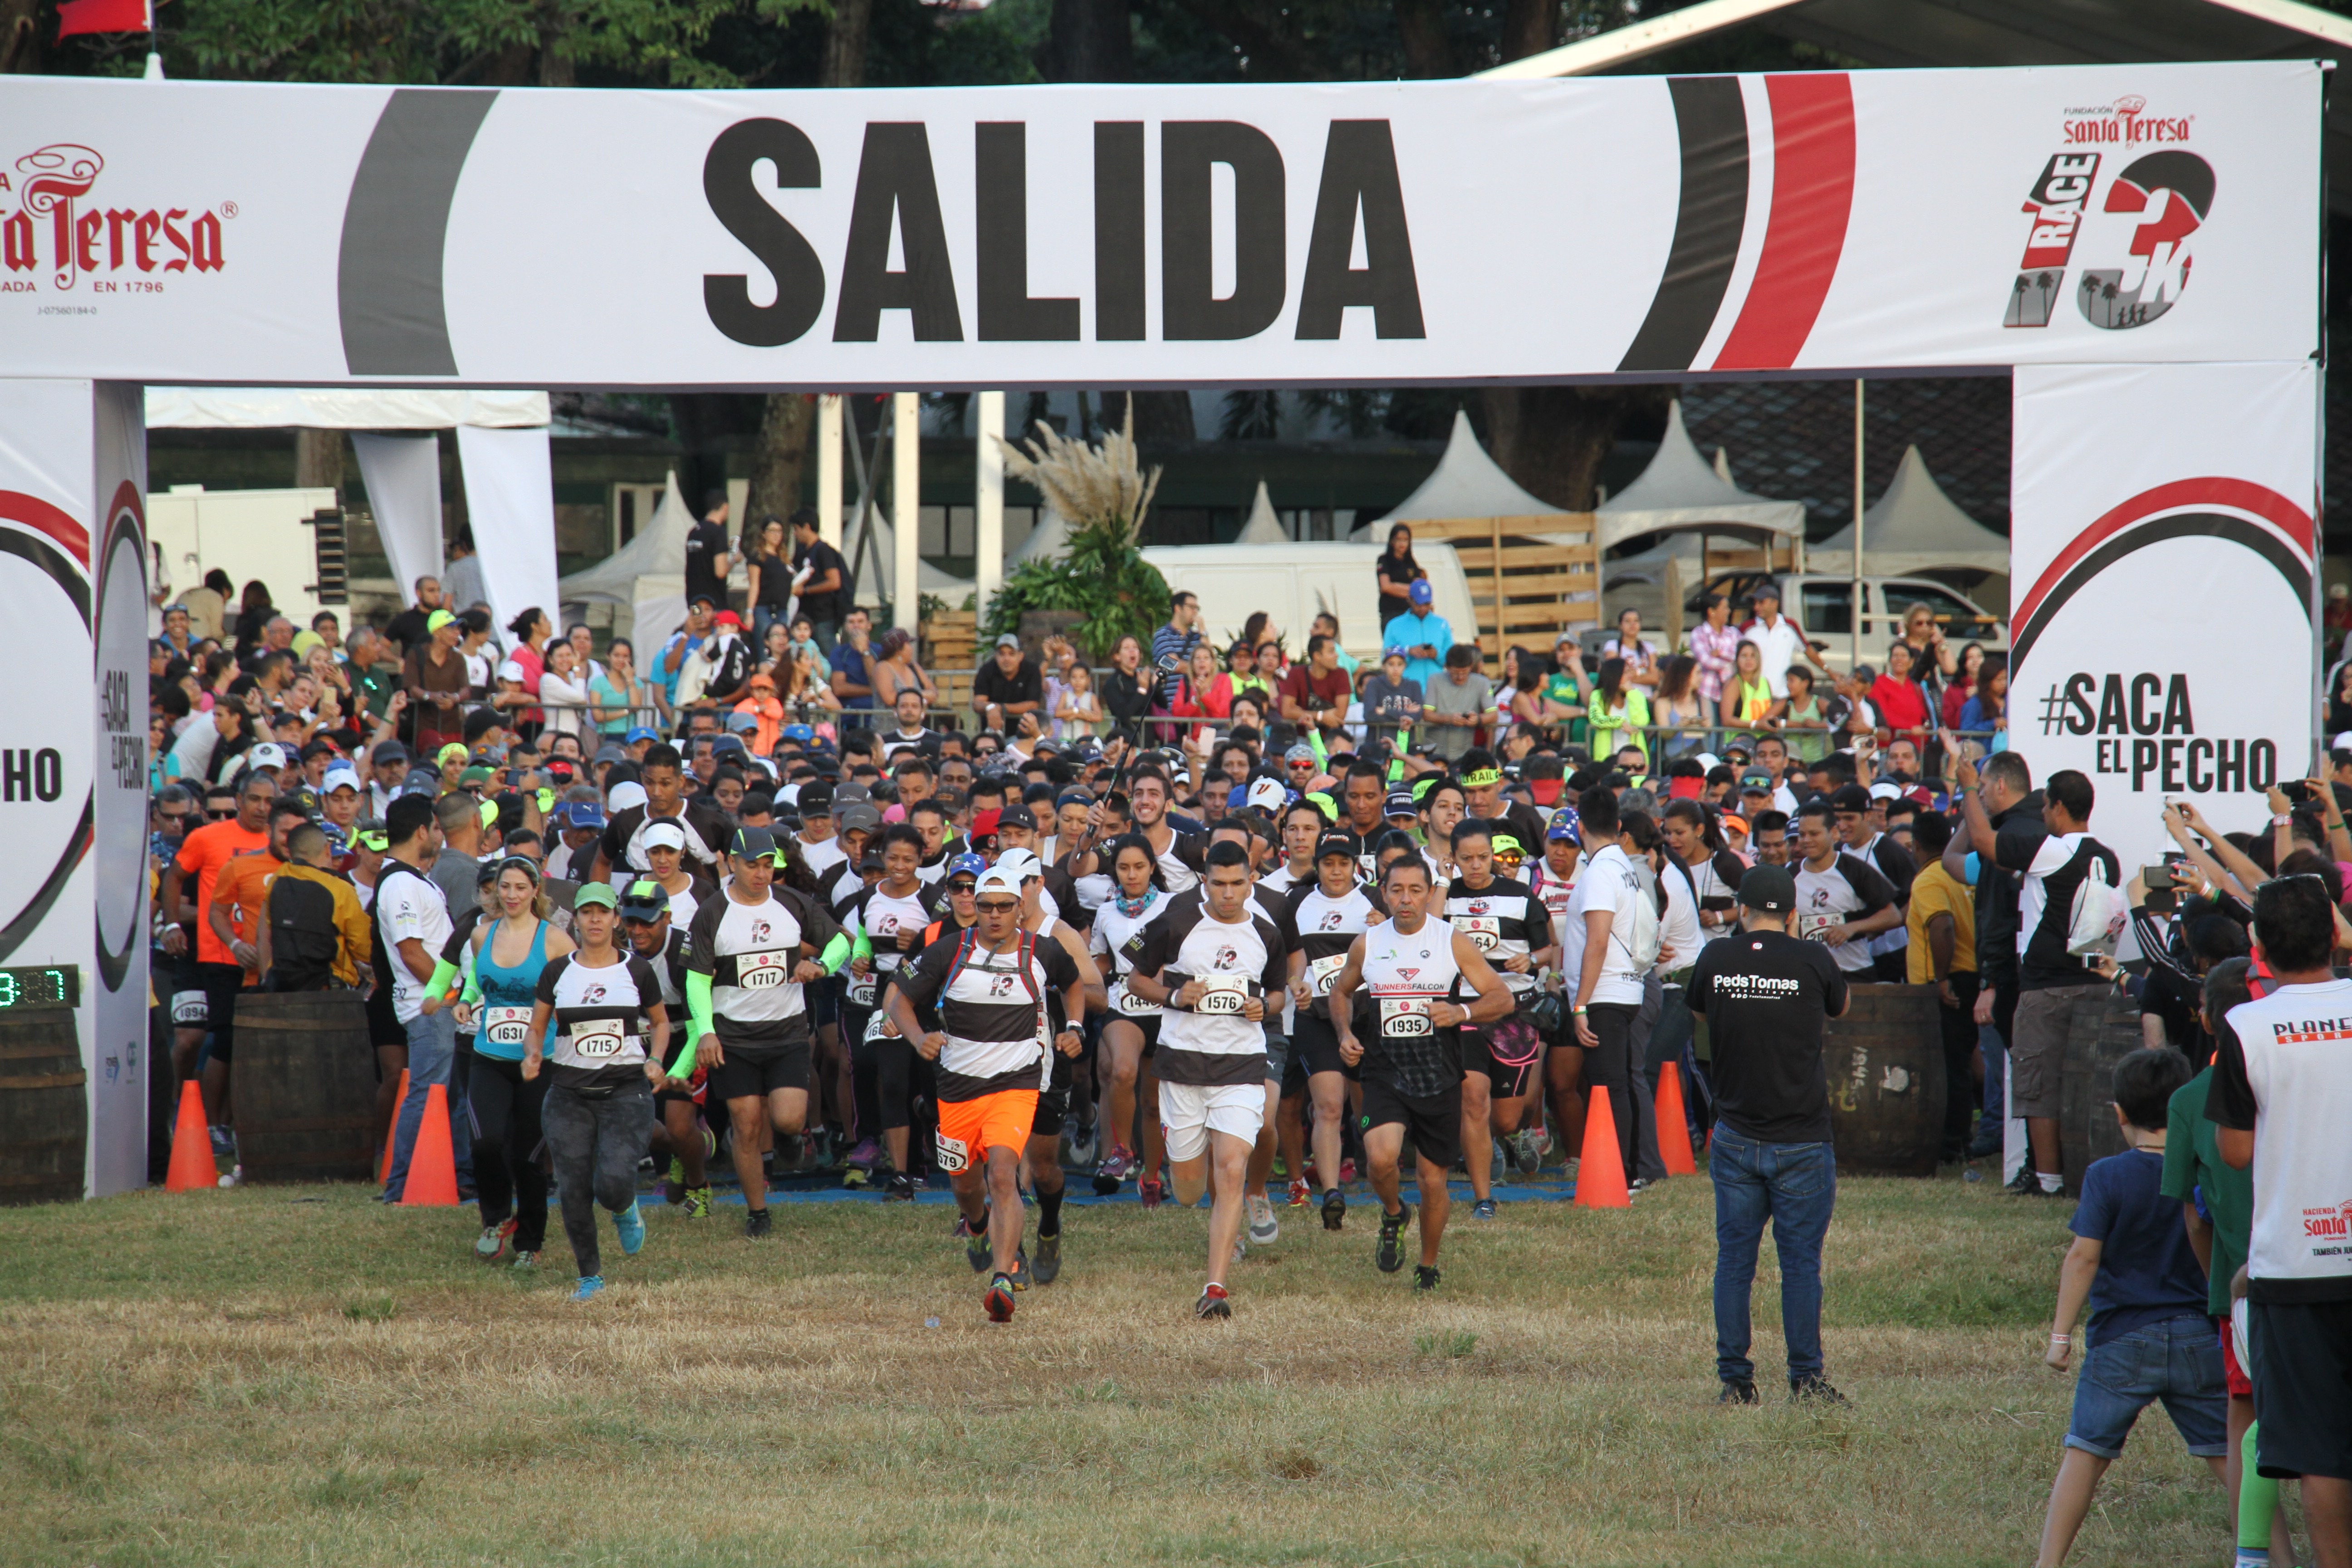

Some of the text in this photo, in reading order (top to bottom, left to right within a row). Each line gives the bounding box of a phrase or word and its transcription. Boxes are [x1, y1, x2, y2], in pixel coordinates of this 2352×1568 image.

[2113, 94, 2190, 150] Teresa
[2029, 154, 2097, 248] RACE
[16, 144, 225, 291] Teresa
[703, 116, 1426, 347] SALIDA
[93, 281, 117, 293] EN
[124, 281, 164, 293] 1796
[732, 651, 743, 680] 5
[2038, 671, 2194, 735] #SACA
[2097, 738, 2277, 793] EL PECHO
[752, 972, 777, 985] 1717
[1373, 982, 1445, 991] RUNNERSFALCON
[1208, 996, 1236, 1009] 1576
[498, 1027, 523, 1039] 1631
[1392, 1019, 1422, 1033] 1935
[2273, 1017, 2352, 1036] PLANE
[587, 1039, 612, 1053] 1715
[2303, 1207, 2336, 1216] HACIENDA
[2312, 1246, 2342, 1256] TAMBIÉN
